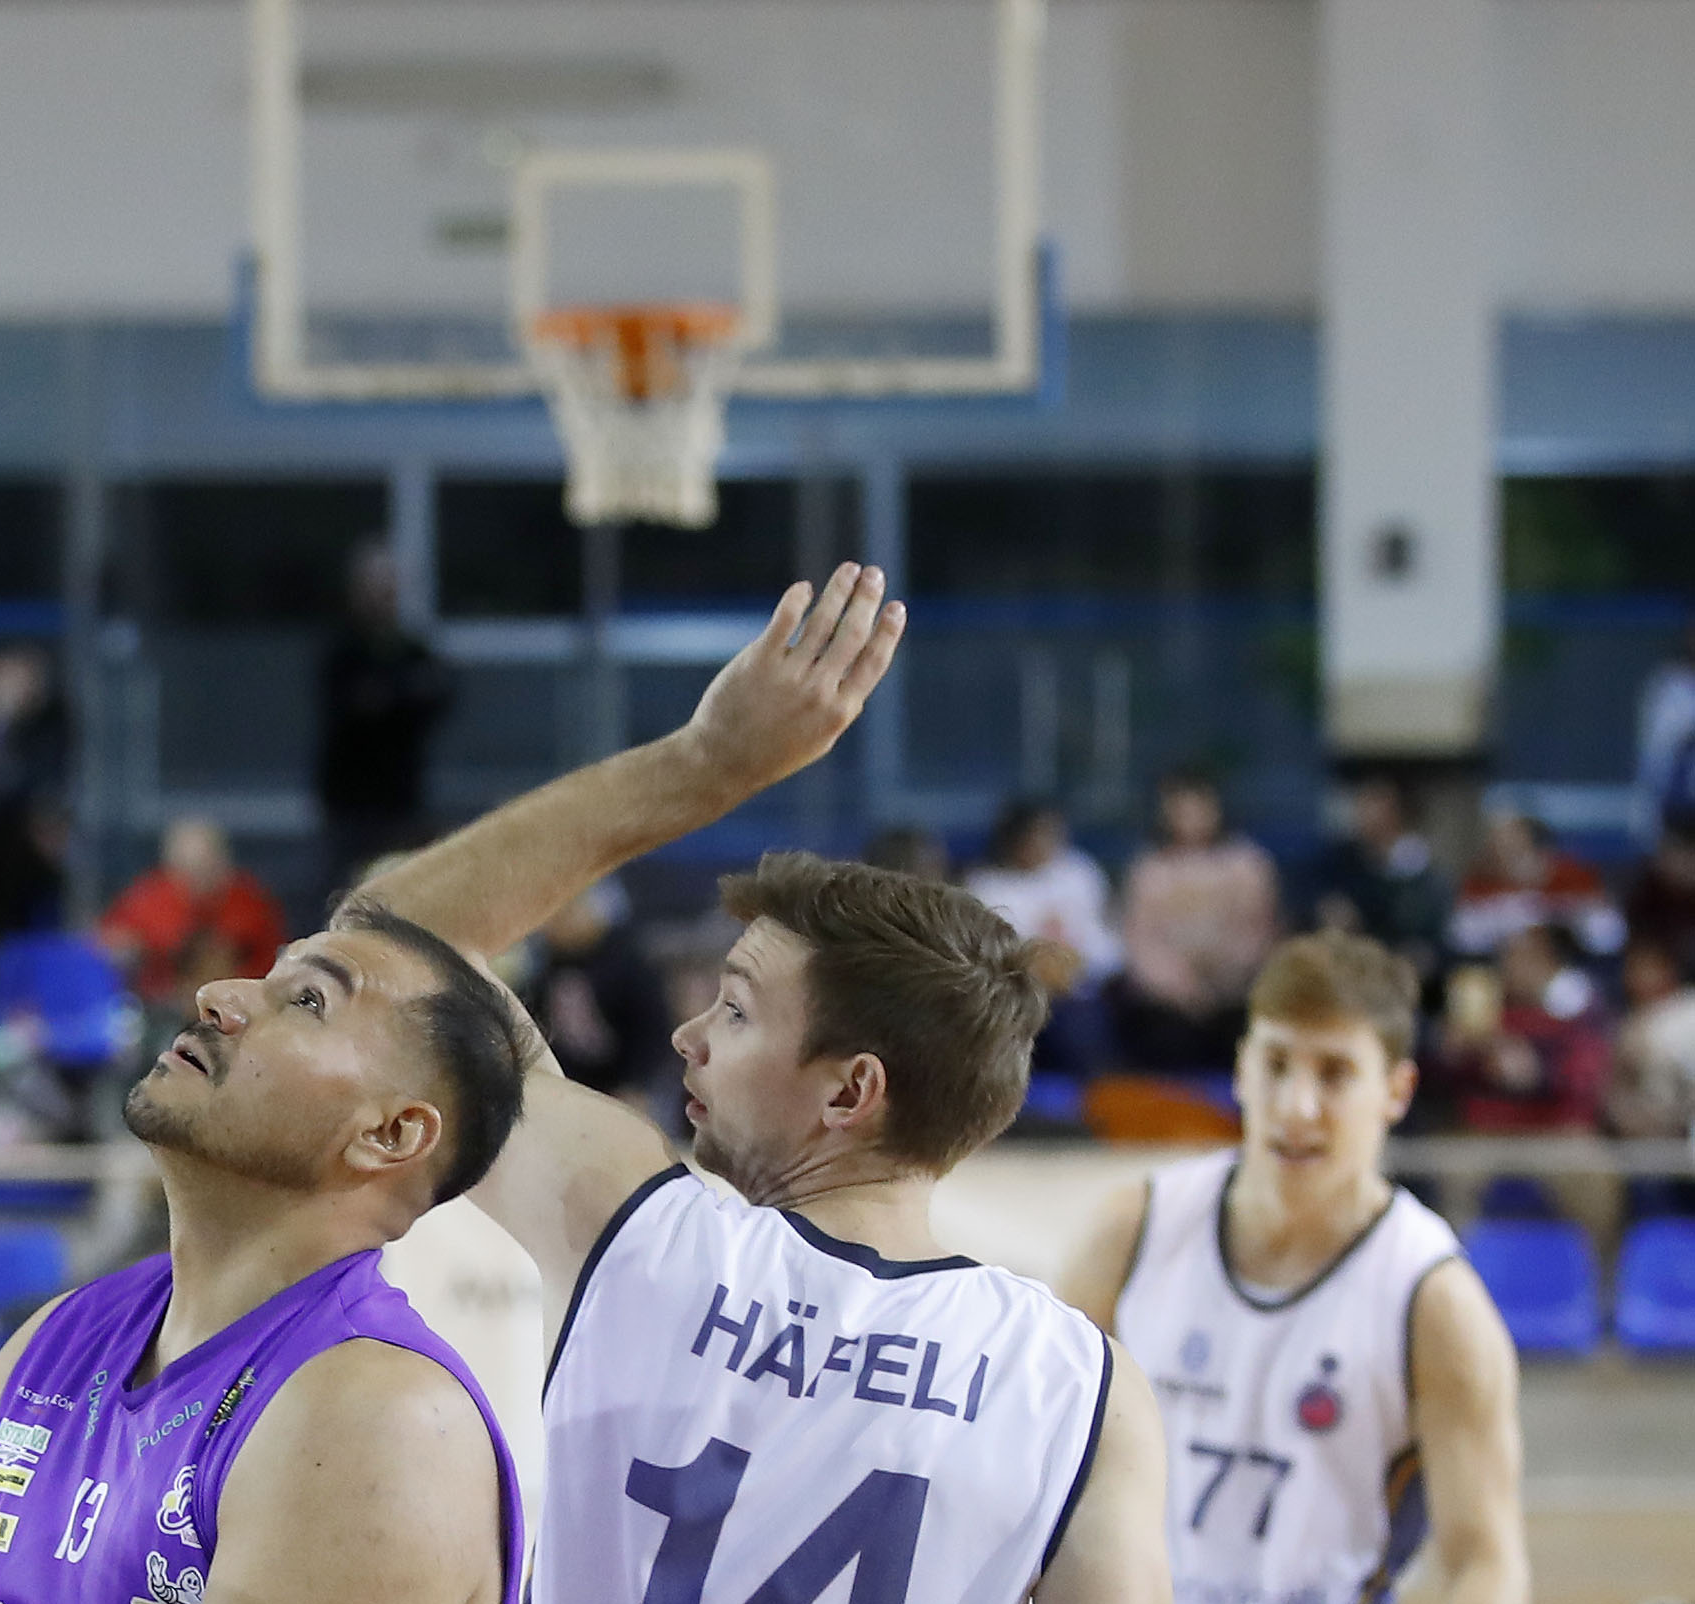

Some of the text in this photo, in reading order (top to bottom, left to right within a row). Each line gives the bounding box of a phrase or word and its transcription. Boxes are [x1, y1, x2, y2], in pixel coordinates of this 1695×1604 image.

[691, 1283, 989, 1422] HÄFELI
[54, 1477, 109, 1564] 13
[1187, 1439, 1293, 1539] 77
